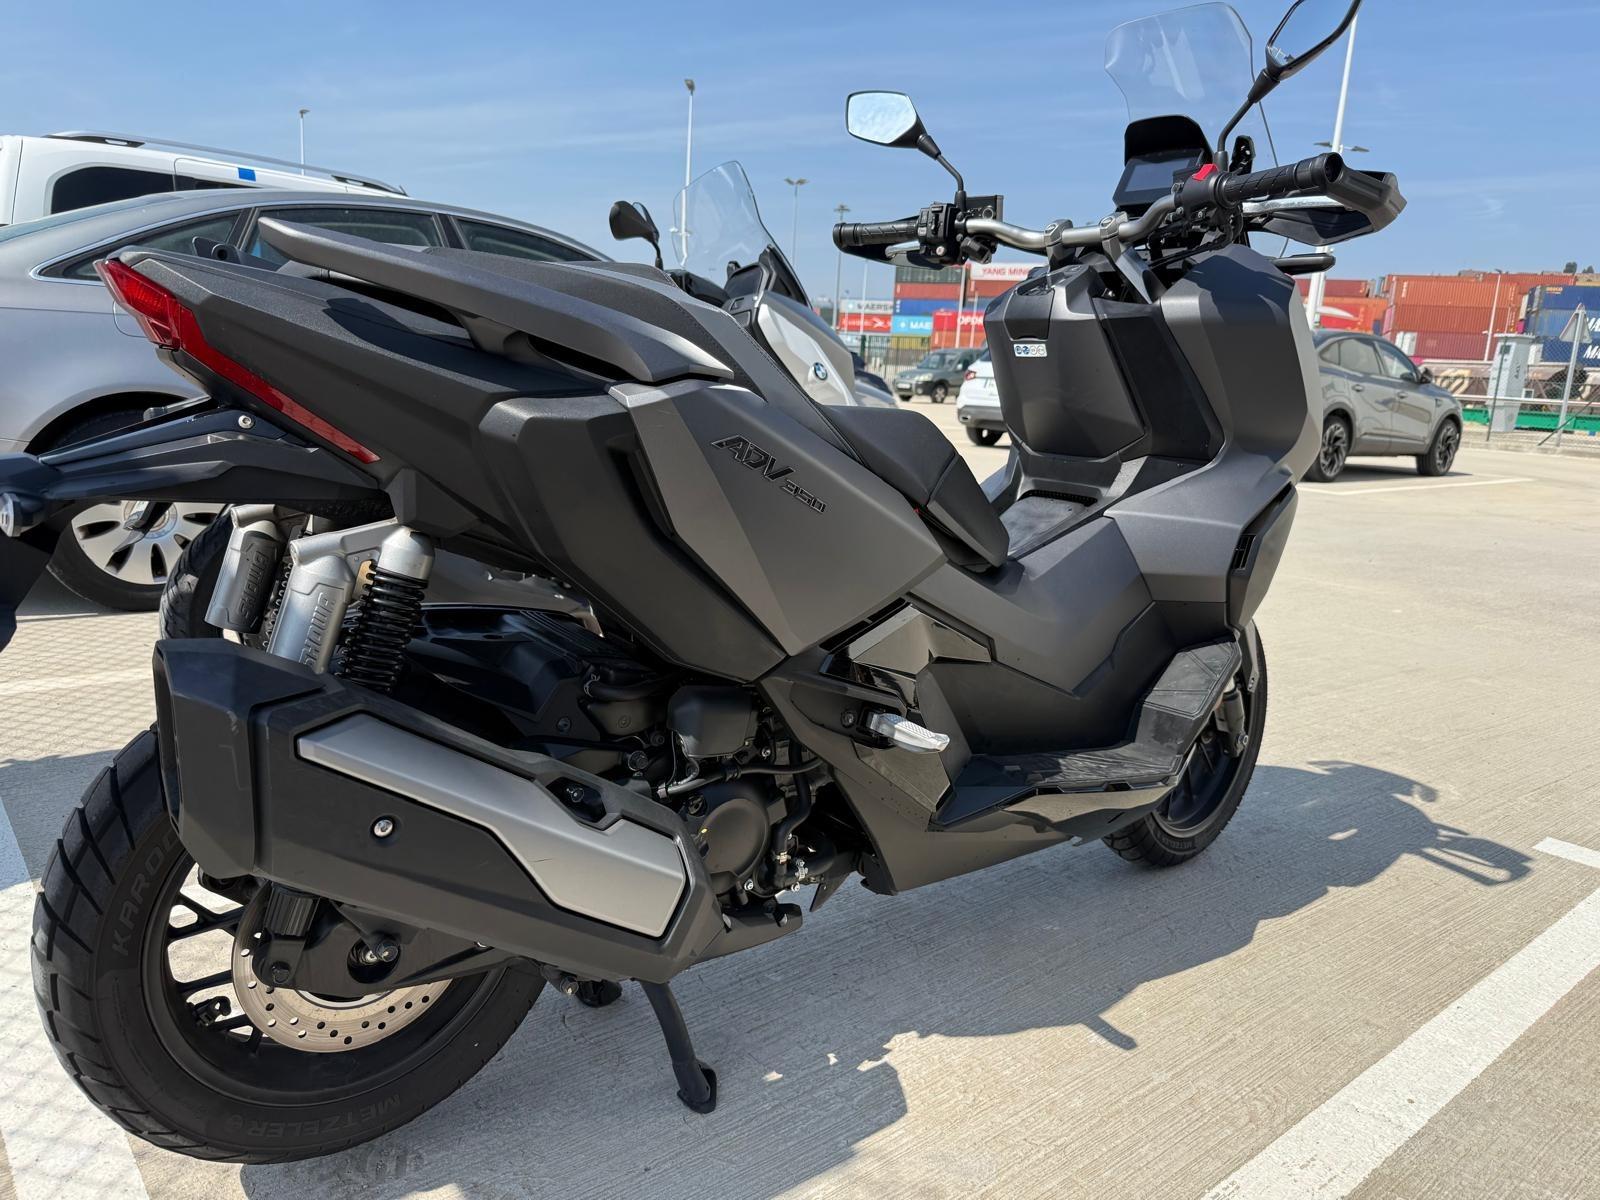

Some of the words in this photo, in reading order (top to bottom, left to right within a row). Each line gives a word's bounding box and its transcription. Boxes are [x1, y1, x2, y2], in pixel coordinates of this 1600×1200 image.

[982, 267, 1006, 275] YANG
[711, 434, 796, 481] ADV
[780, 479, 827, 514] 350
[239, 550, 270, 619] SHOWA
[299, 591, 335, 667] SHOWA
